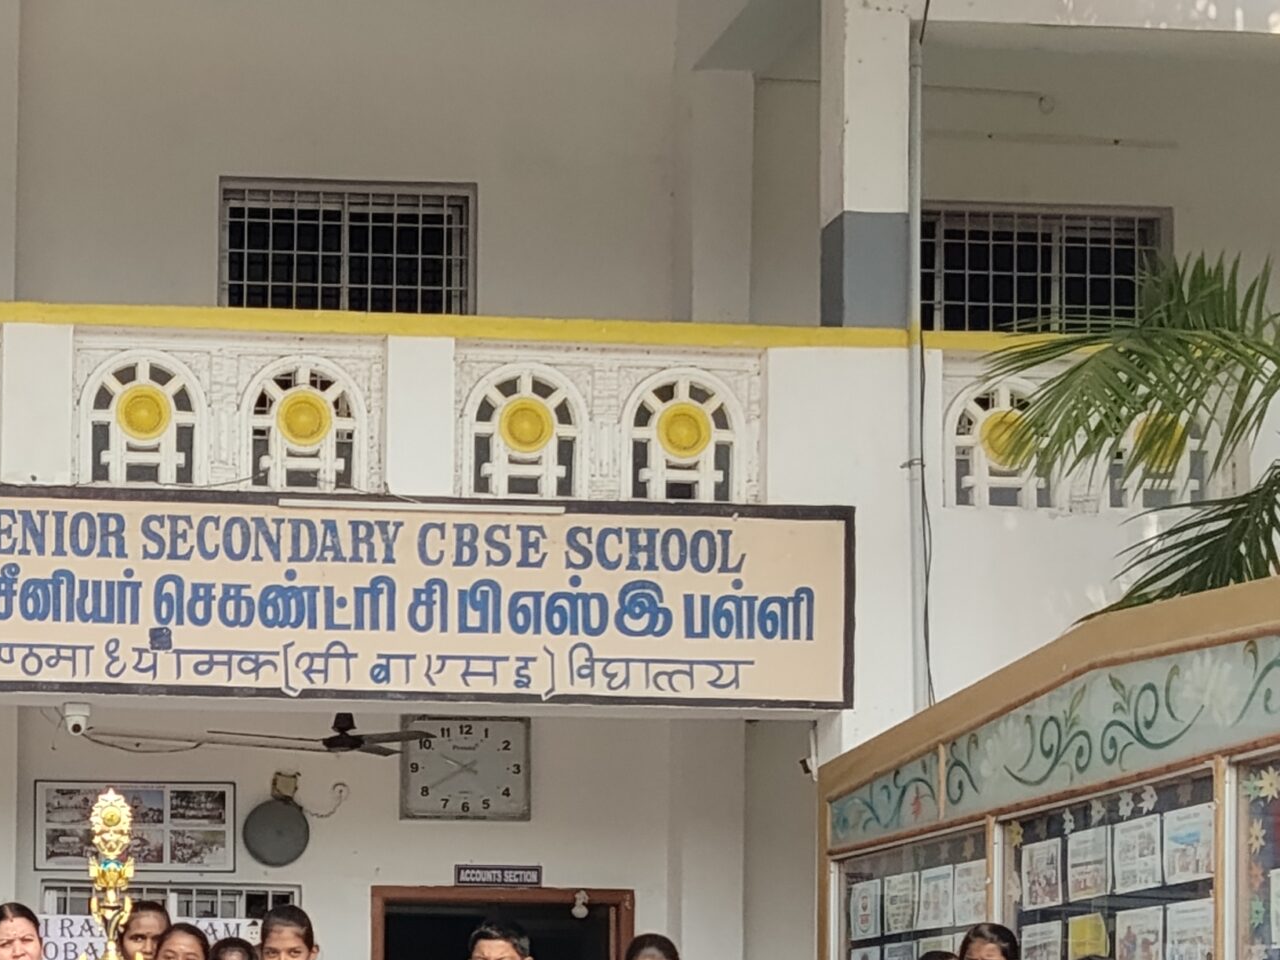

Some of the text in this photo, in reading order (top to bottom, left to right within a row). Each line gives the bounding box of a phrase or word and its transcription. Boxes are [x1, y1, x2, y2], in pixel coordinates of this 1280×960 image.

[141, 514, 404, 564] SECONDARY
[417, 521, 547, 569] CBSE
[565, 526, 746, 574] SCHOOL
[440, 727, 450, 738] 11
[459, 724, 473, 735] 12
[484, 728, 488, 738] 1
[419, 738, 432, 750] 10
[502, 740, 511, 751] 2
[410, 762, 419, 773] 9
[512, 764, 521, 774] 3
[420, 786, 429, 797] 8
[501, 787, 511, 797] 4
[440, 798, 449, 809] 7
[461, 802, 470, 812] 6
[482, 799, 490, 809] 5
[460, 869, 538, 883] ACCOUNTS SECTION
